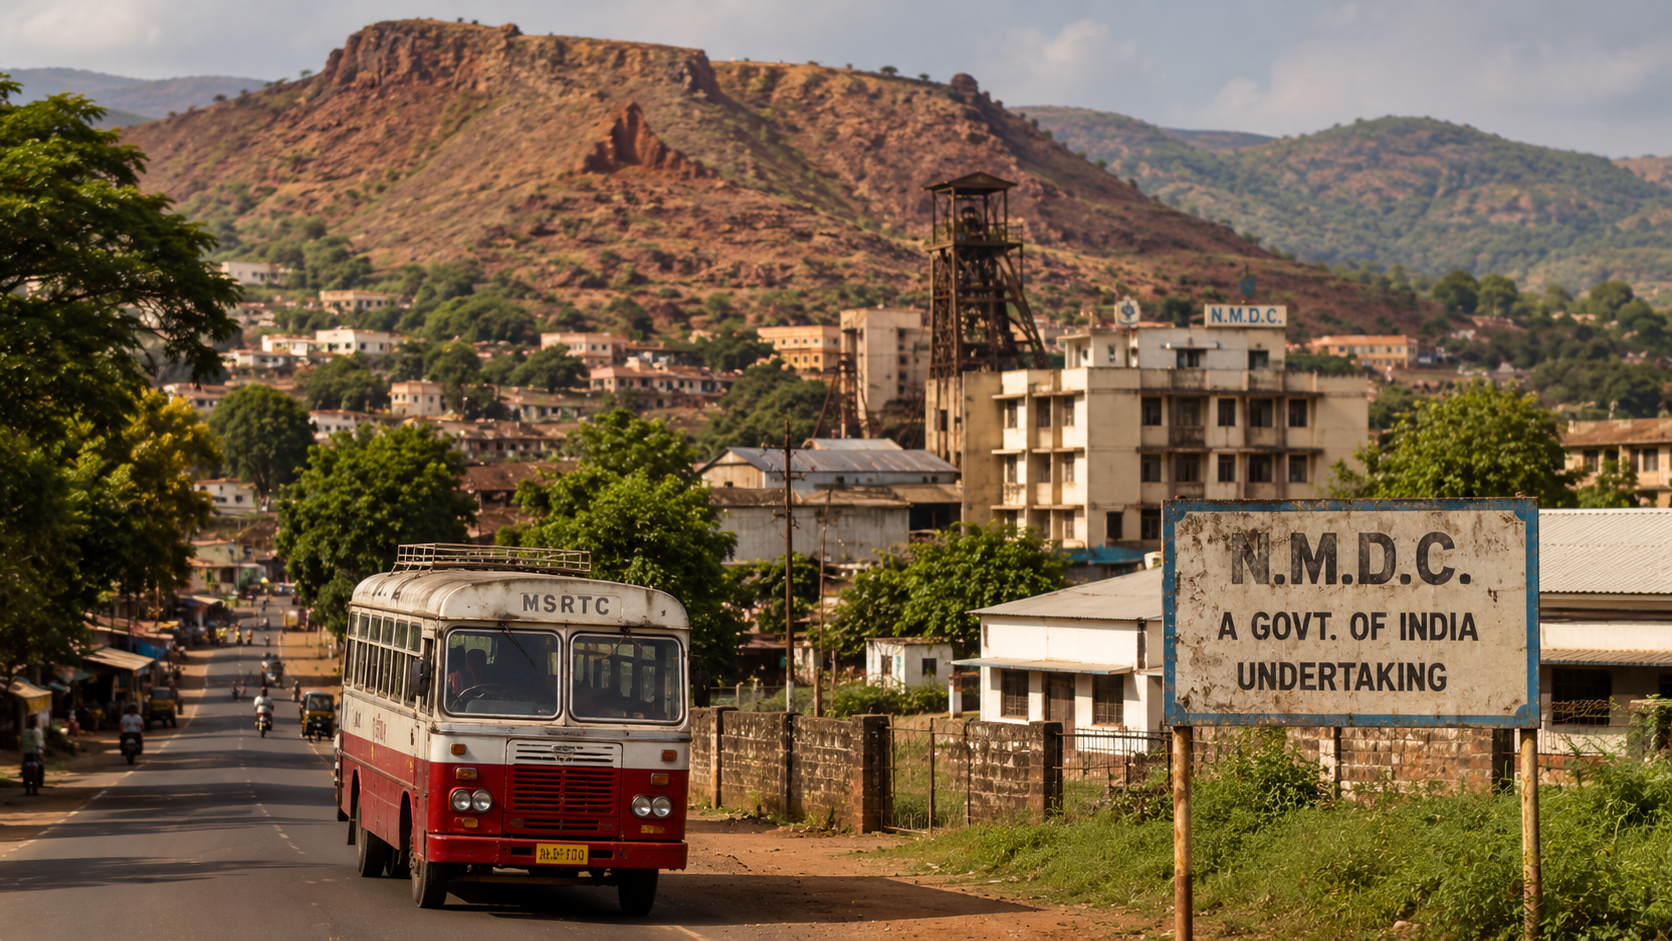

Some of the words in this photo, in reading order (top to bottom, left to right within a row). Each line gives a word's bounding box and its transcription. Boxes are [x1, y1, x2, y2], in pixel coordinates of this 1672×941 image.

[1211, 307, 1282, 324] N.M.D.C.
[1231, 531, 1471, 586] N.M.D.C.
[522, 594, 610, 615] MSRTC
[1217, 612, 1238, 640] A
[1251, 612, 1337, 641] GOVT.
[1350, 612, 1387, 641] OF
[1400, 612, 1479, 641] INDIA
[1237, 662, 1448, 692] UNDERTAKING
